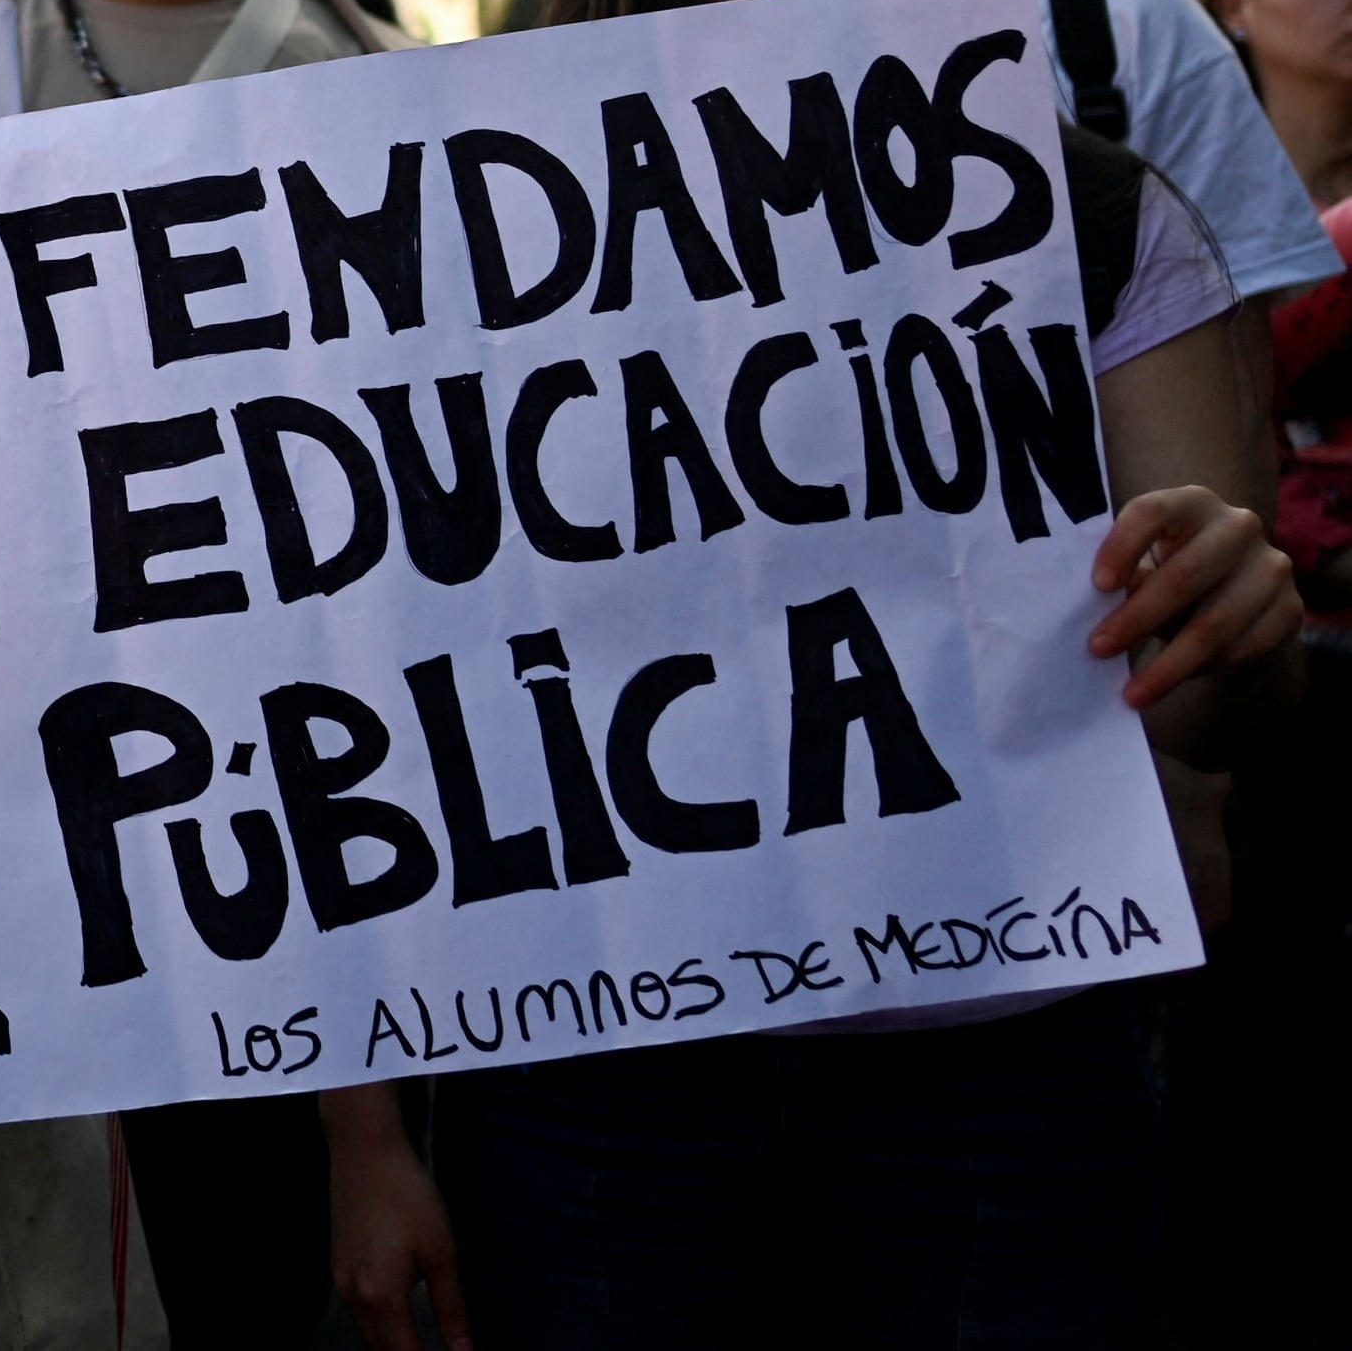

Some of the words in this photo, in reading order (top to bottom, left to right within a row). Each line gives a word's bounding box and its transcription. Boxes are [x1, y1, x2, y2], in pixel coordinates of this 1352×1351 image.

[78, 279, 1109, 633] EDUCACIÓN
[209, 1006, 322, 1079] LOS
[729, 939, 845, 1006] DE
